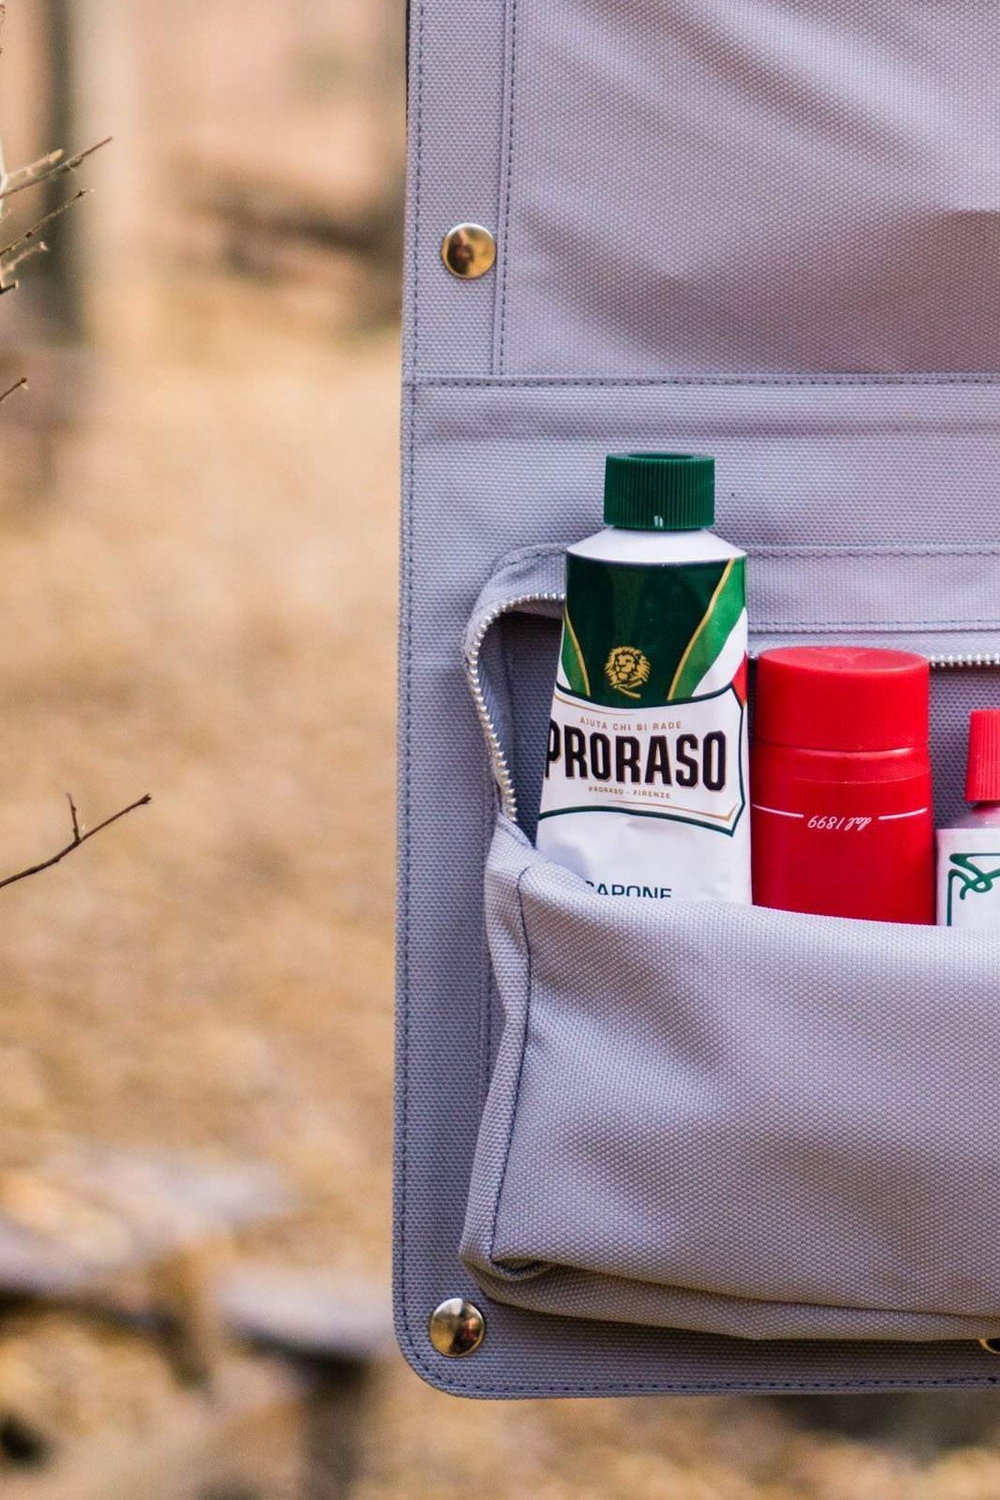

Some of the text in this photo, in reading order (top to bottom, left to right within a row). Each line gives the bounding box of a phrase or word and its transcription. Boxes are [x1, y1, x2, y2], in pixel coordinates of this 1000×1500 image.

[579, 716, 682, 732] AIUTA CHI SI RADE
[545, 717, 727, 792] PRORASO
[632, 788, 671, 800] FIRENZE
[807, 815, 846, 830] 1899
